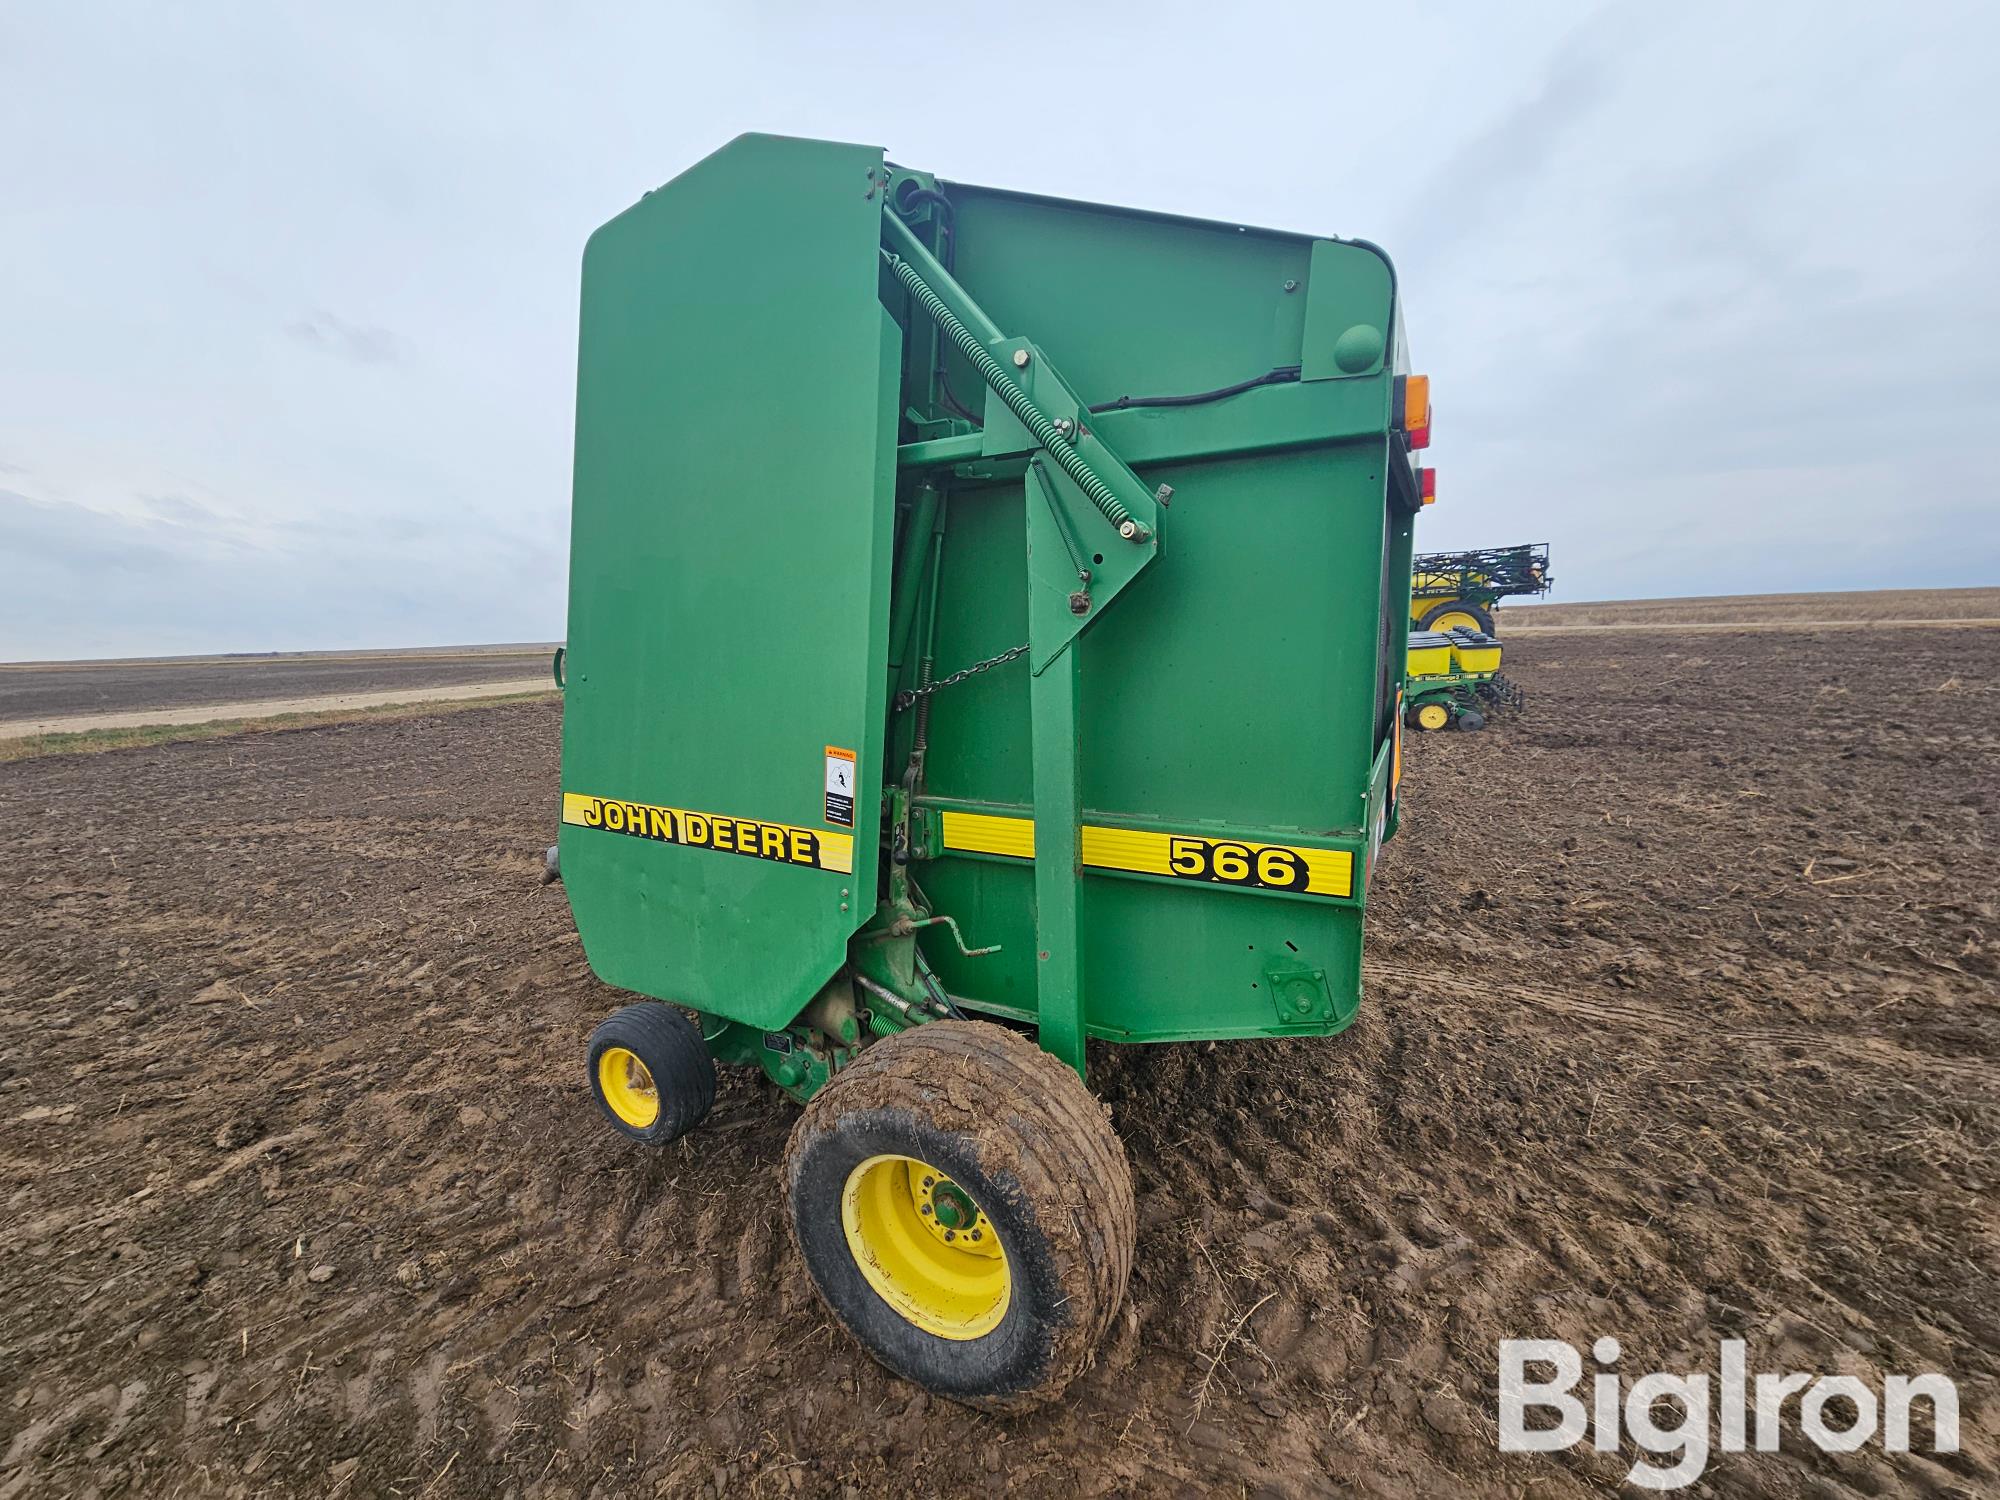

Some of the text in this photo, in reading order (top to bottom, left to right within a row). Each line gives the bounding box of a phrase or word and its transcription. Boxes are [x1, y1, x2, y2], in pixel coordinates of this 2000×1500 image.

[583, 800, 815, 865] JOHN DEERE
[1170, 838, 1299, 887] 566
